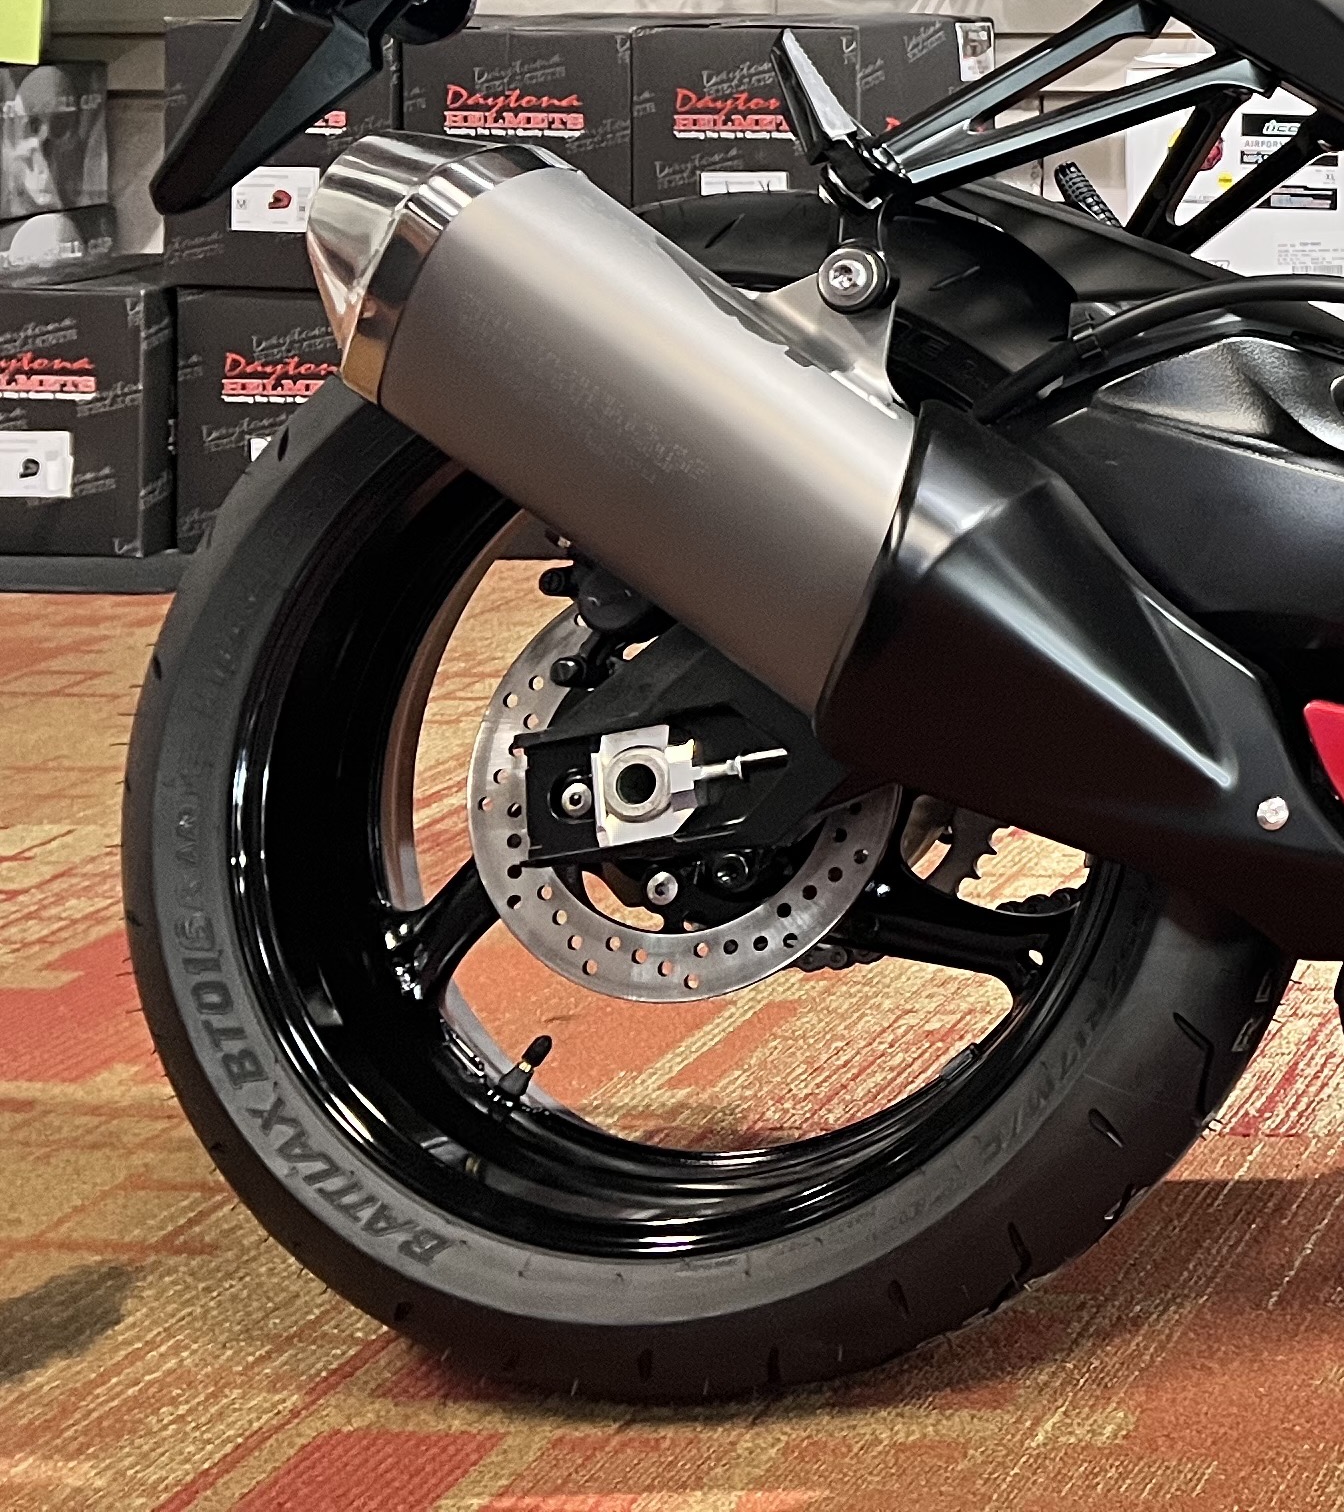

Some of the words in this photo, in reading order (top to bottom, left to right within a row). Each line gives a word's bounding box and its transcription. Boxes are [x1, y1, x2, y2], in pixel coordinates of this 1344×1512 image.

[446, 83, 583, 116] Daytona
[444, 110, 586, 130] HELMETS
[258, 1095, 453, 1267] BATTLAX
